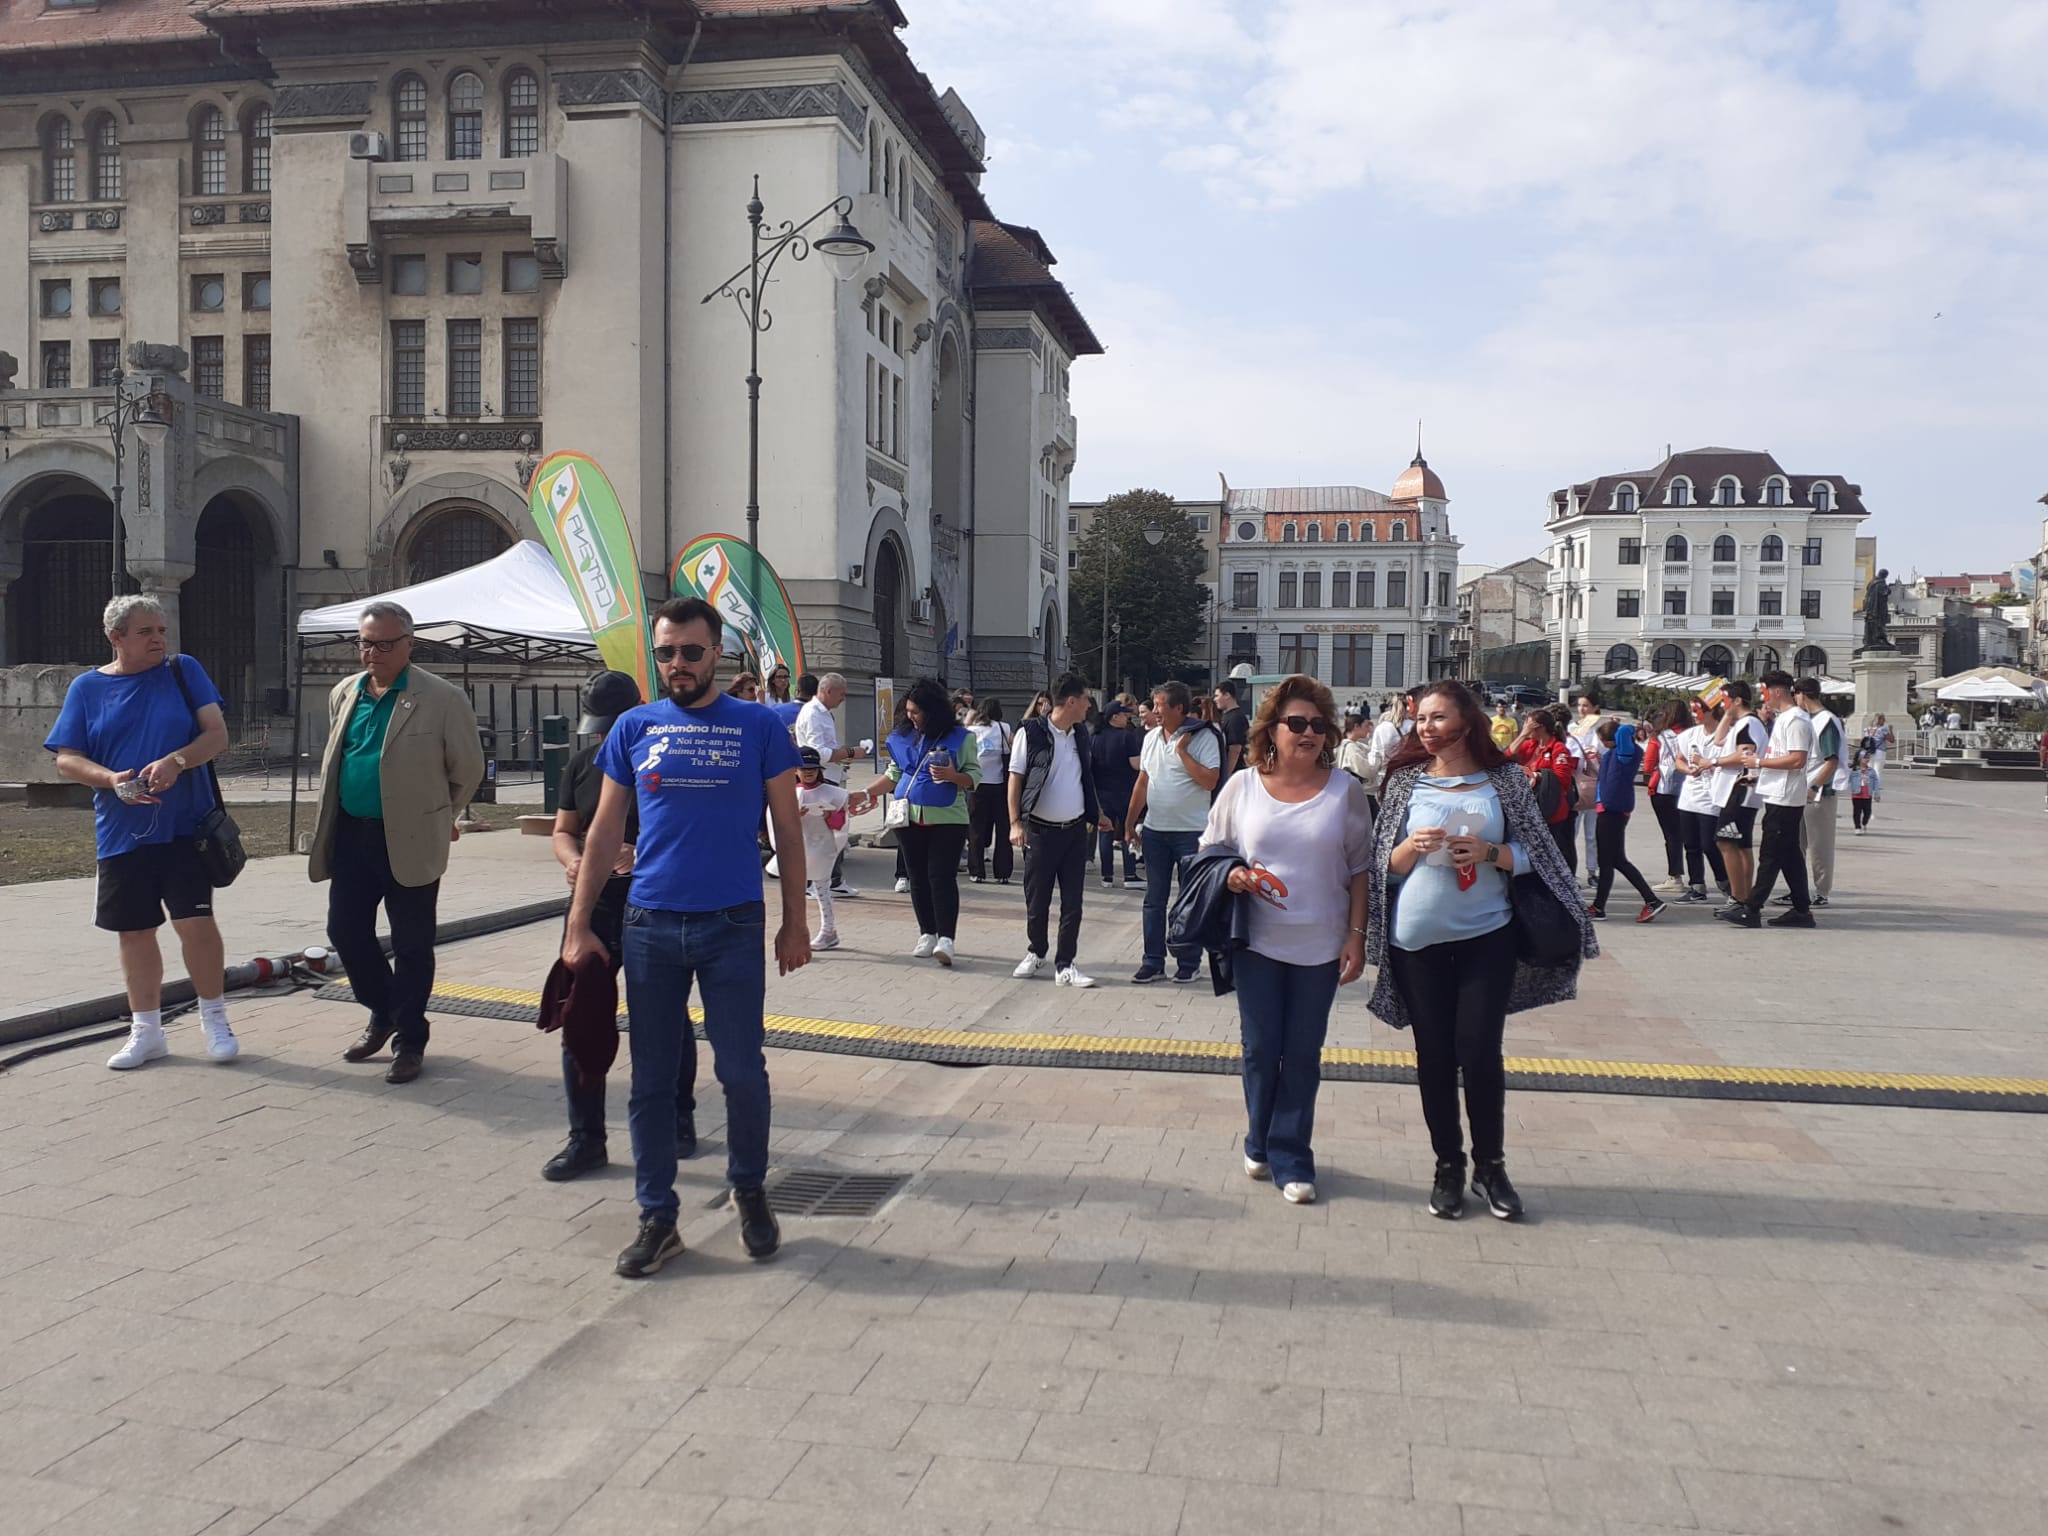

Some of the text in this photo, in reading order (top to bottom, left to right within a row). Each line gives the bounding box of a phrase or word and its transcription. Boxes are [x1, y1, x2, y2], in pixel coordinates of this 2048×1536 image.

[675, 737, 741, 748] Noi ne-am pus
[697, 747, 706, 756] la
[690, 758, 703, 766] Tu
